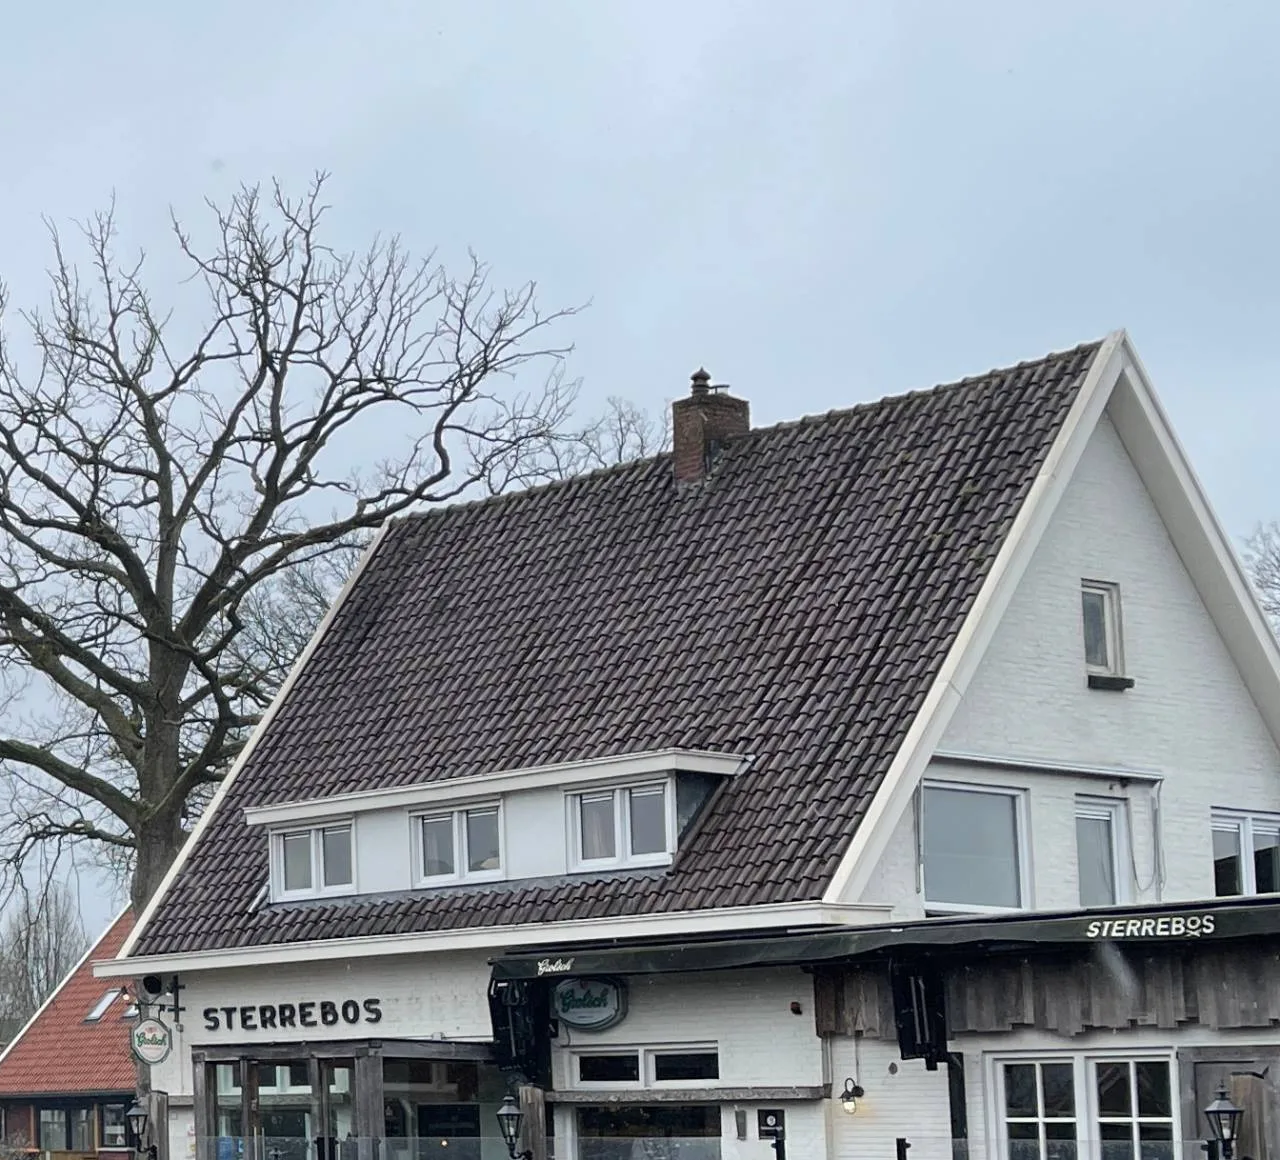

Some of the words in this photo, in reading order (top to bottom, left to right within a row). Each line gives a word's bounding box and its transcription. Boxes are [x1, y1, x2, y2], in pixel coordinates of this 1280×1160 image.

[1086, 915, 1215, 937] STERREBOS
[537, 957, 575, 976] Grolsch
[560, 987, 610, 1014] Grolsch
[203, 998, 383, 1032] STERREBOS
[136, 1031, 167, 1048] Grolsch
